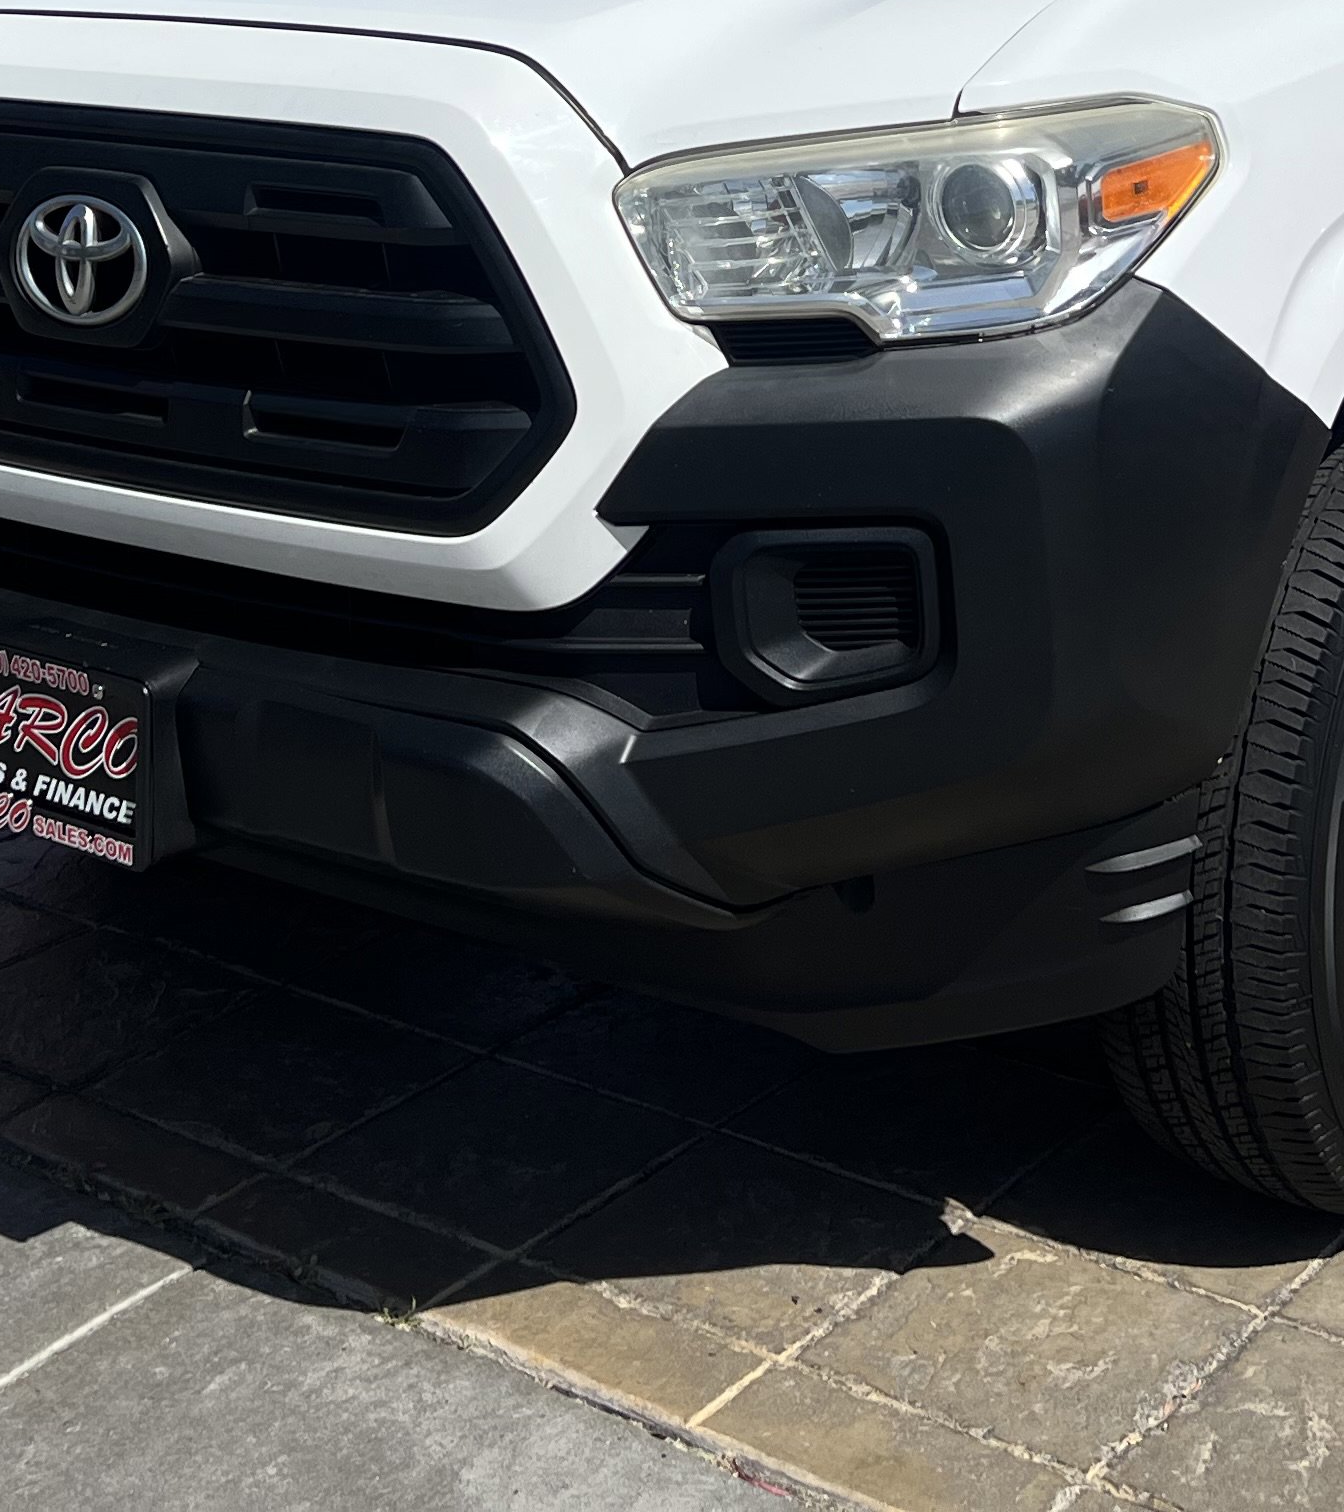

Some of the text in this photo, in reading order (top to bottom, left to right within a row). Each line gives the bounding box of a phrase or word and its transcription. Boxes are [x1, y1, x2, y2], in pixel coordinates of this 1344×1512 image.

[10, 655, 90, 697] 420-5700
[10, 768, 28, 792] &
[33, 774, 137, 825] FINANCE
